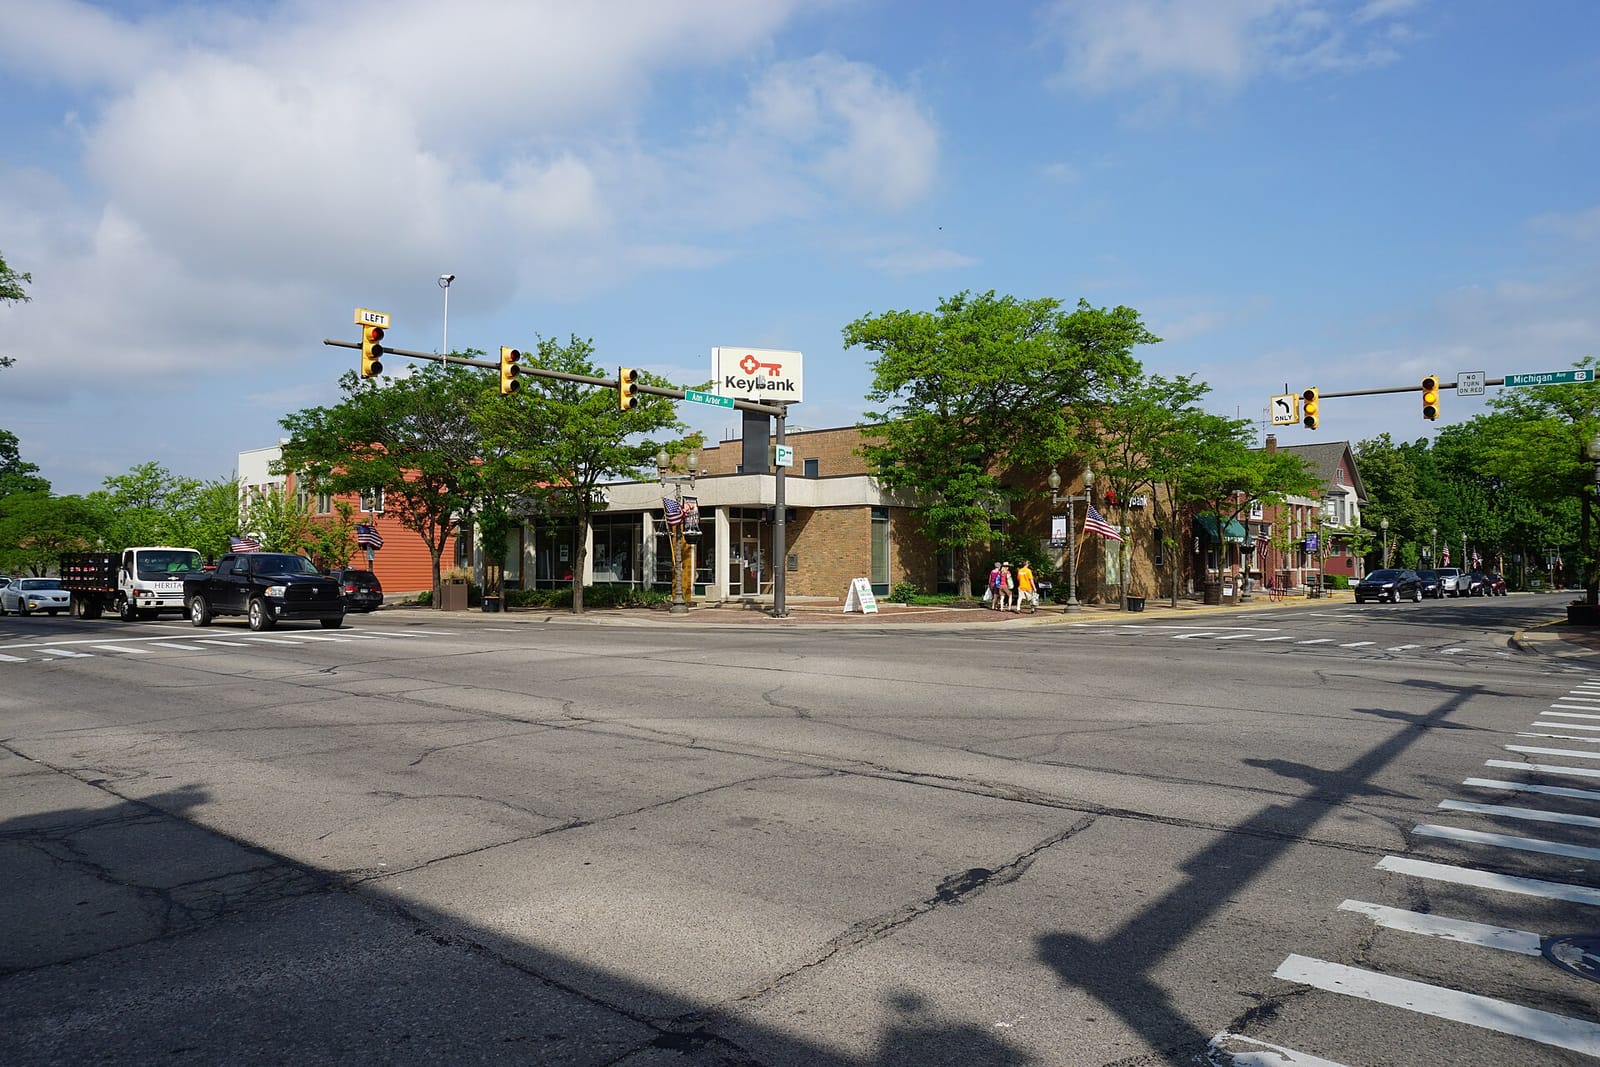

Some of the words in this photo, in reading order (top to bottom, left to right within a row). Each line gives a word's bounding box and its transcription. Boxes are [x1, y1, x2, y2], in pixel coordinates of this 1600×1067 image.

[365, 313, 385, 324] LEFT
[1513, 374, 1553, 384] Michigan
[691, 393, 703, 402] Ann
[705, 395, 721, 405] Arbor
[778, 447, 786, 462] P
